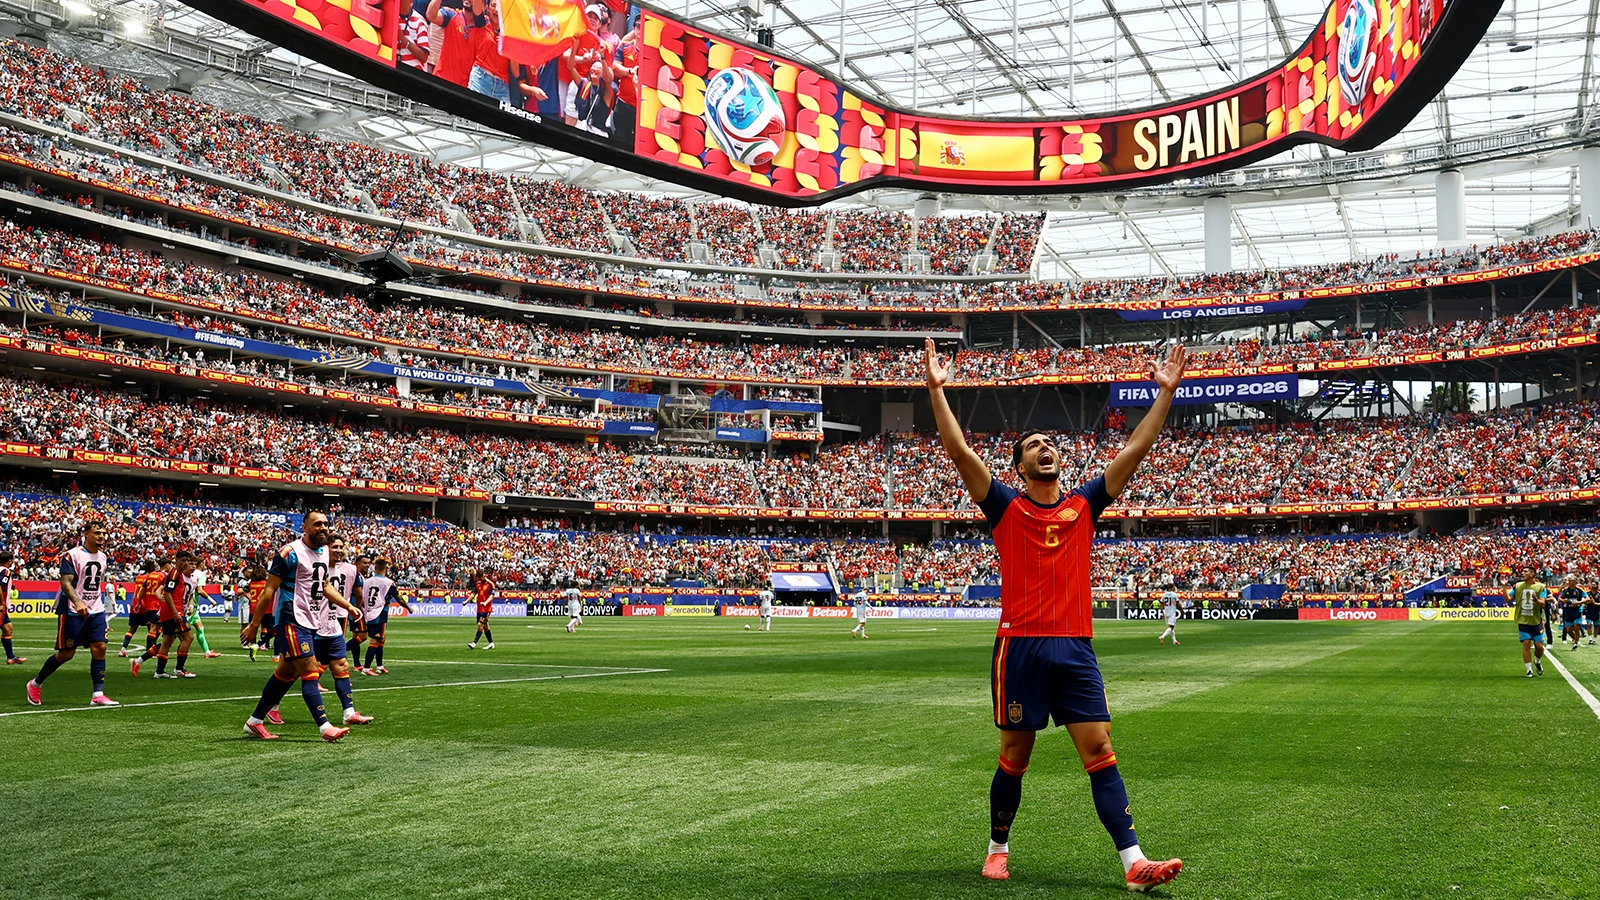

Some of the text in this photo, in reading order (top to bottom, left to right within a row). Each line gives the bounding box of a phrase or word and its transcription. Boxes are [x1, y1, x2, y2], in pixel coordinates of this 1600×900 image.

[499, 100, 542, 124] Hisense
[1133, 96, 1240, 172] SPAIN
[1508, 264, 1533, 276] GOAL!
[1425, 277, 1444, 286] SPAIN
[1361, 283, 1386, 293] GOAL!
[1282, 291, 1300, 300] SPAIN
[1163, 305, 1264, 319] LOS ANGELES
[195, 331, 245, 349] #FIFAWorldCup
[1530, 339, 1557, 350] GOAL!
[26, 341, 46, 352] SPAIN
[1378, 355, 1404, 365] GOAL!
[1446, 350, 1465, 360] SPAIN
[115, 356, 140, 367] GOAL!
[179, 366, 196, 377] SPAIN
[1233, 367, 1257, 375] GOAL!
[1297, 363, 1315, 372] SPAIN
[393, 366, 494, 387] FIFA WORLD CUP 2026
[1119, 381, 1288, 400] FIFA WRLD CUP 2026
[46, 448, 69, 459] SPAIN
[142, 458, 170, 469] GOAL!
[212, 465, 230, 475] SPAIN
[291, 475, 315, 484] GOAL!
[350, 479, 366, 488] SPAIN
[446, 488, 461, 497] SPAIN
[1549, 491, 1570, 501] GOAL!
[1505, 495, 1522, 504] SPAIN
[1044, 524, 1060, 547] 6
[146, 580, 159, 595] 22
[35, 601, 57, 613] libr
[1164, 596, 1172, 607] 21
[419, 604, 454, 615] kraken
[470, 604, 527, 615] ken.com
[533, 605, 569, 616] MARRIO
[631, 606, 657, 616] Lenovo
[726, 606, 759, 616] Betano
[812, 607, 847, 617] Betano
[865, 608, 894, 617] etano
[910, 607, 948, 617] kraken
[1127, 608, 1256, 619] MAROTT BONVOY
[1330, 609, 1377, 619] Lenovo
[1440, 608, 1486, 618] mercado
[1487, 608, 1510, 618] libre
